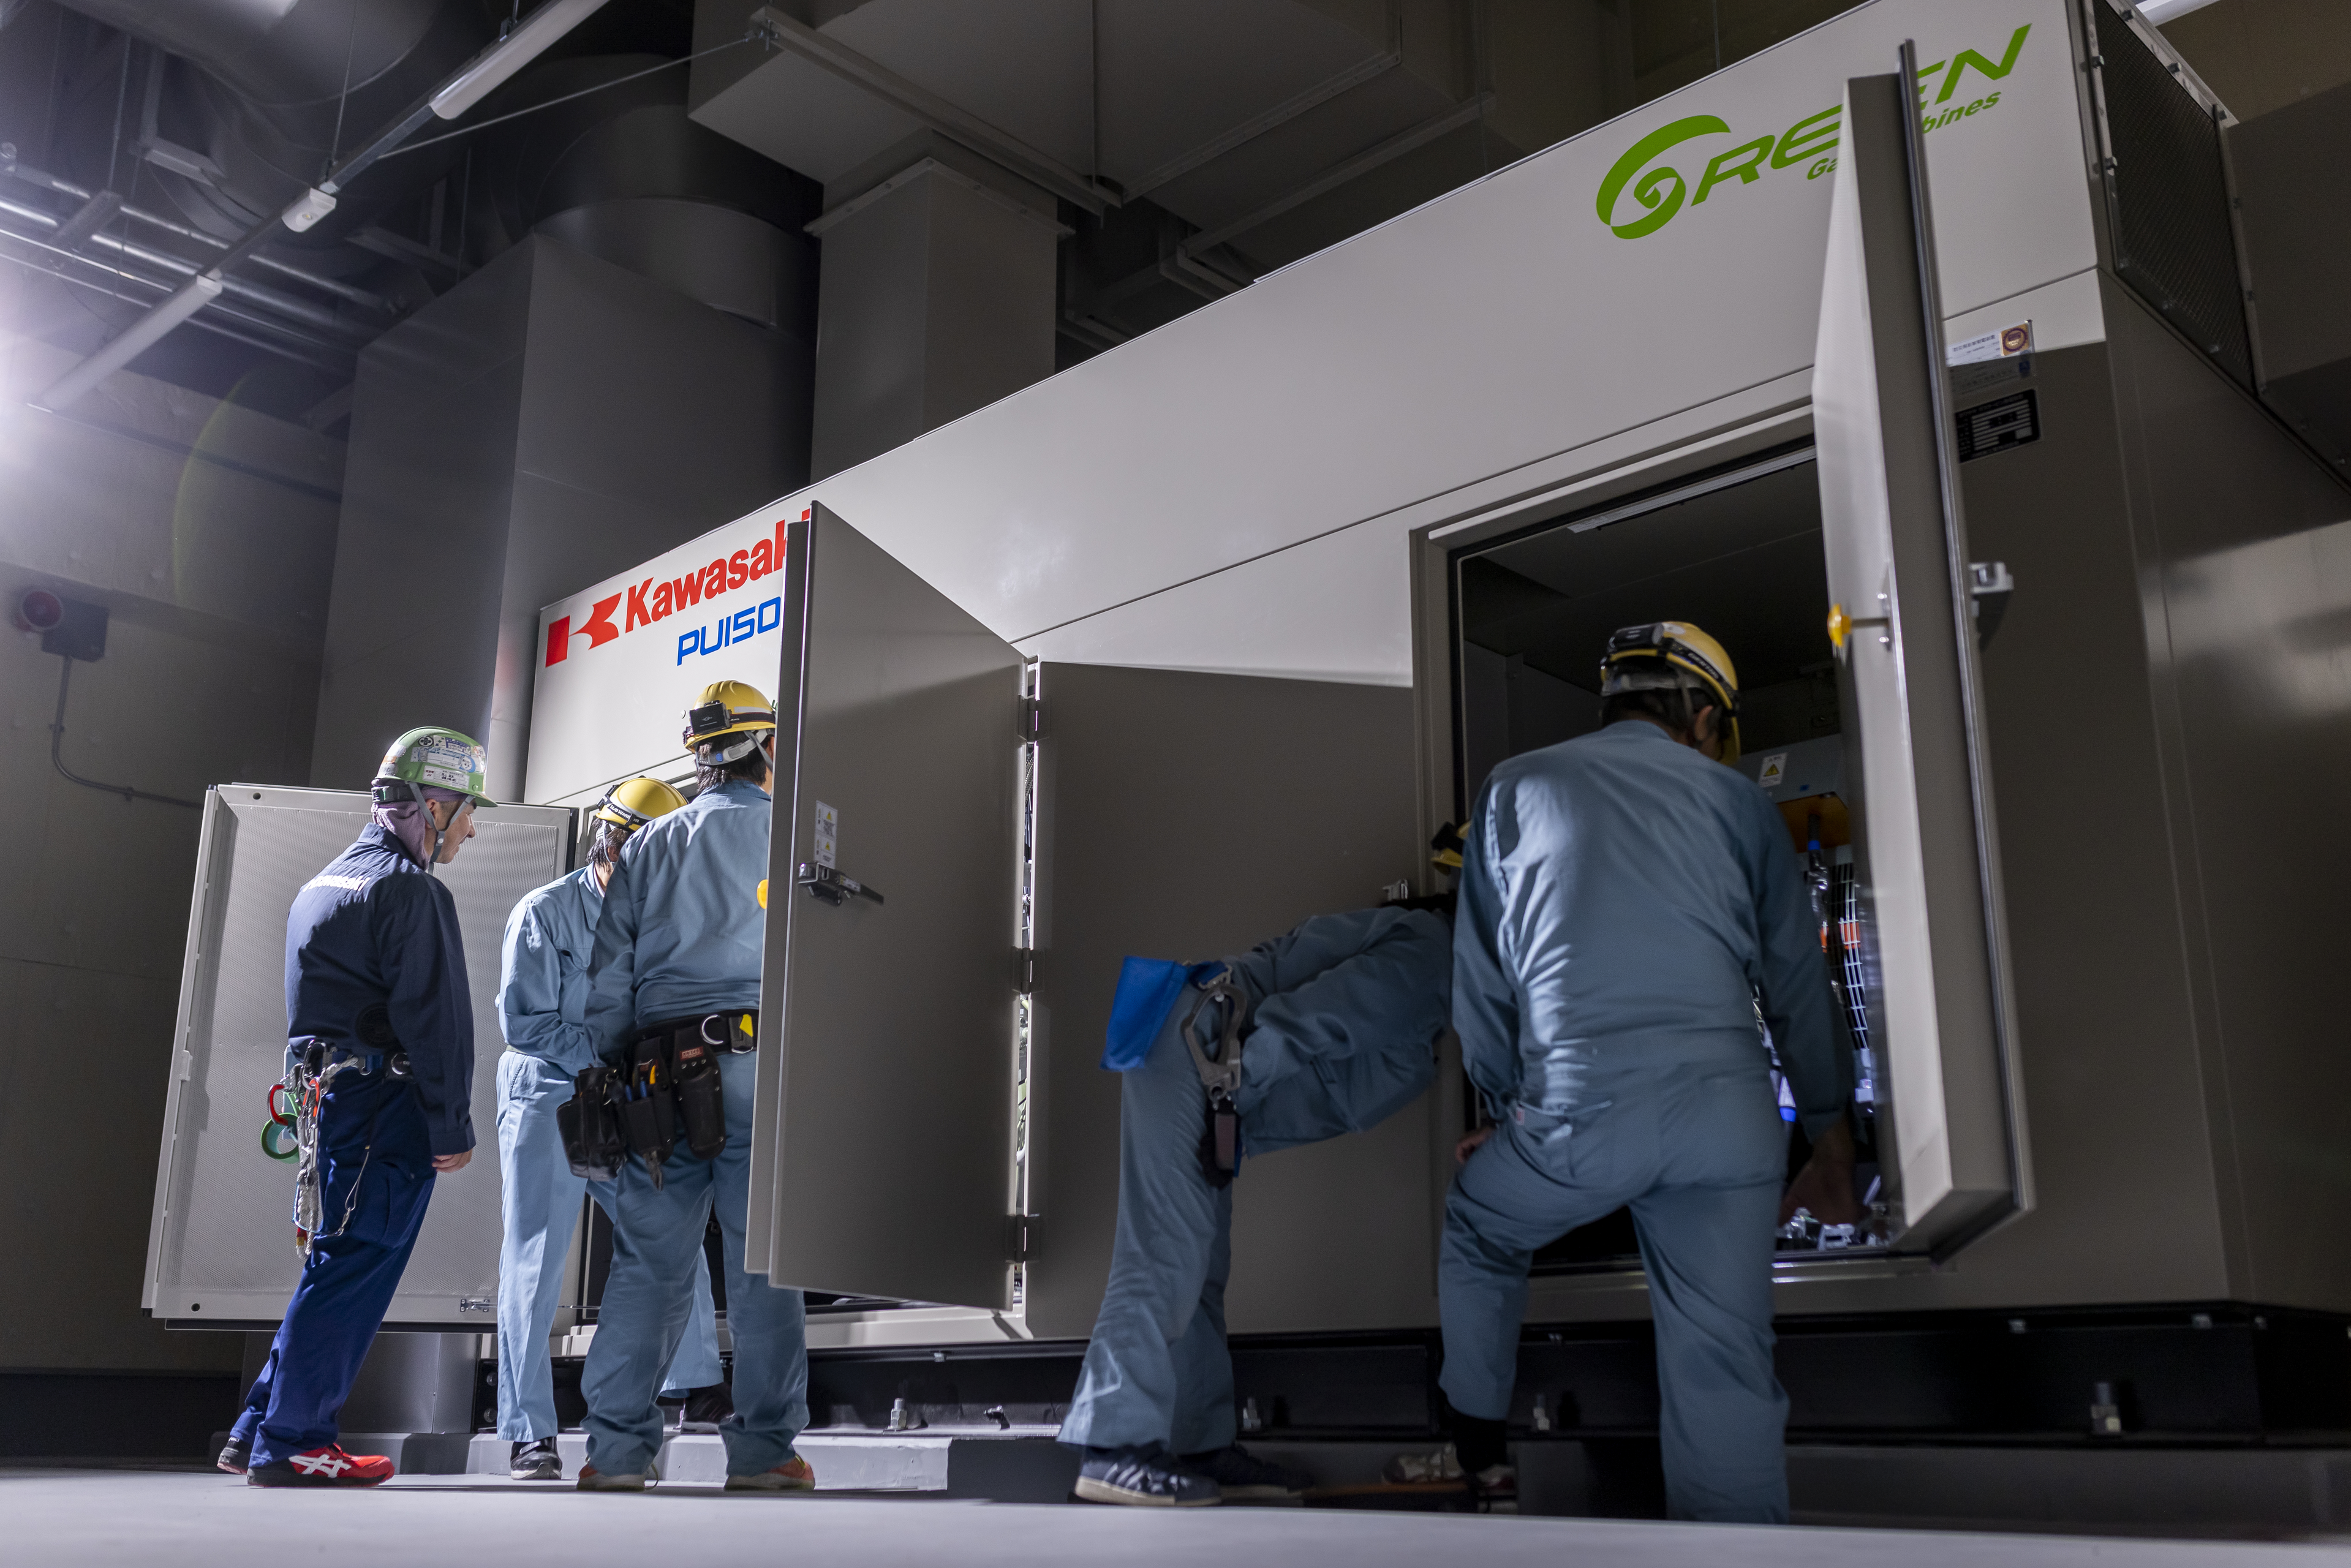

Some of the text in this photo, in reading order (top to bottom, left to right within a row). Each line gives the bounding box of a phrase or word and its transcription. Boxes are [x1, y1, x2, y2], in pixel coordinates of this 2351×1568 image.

[1596, 22, 2032, 239] GREN
[1807, 91, 2002, 180] Ga bines
[625, 508, 810, 633] Kawasak
